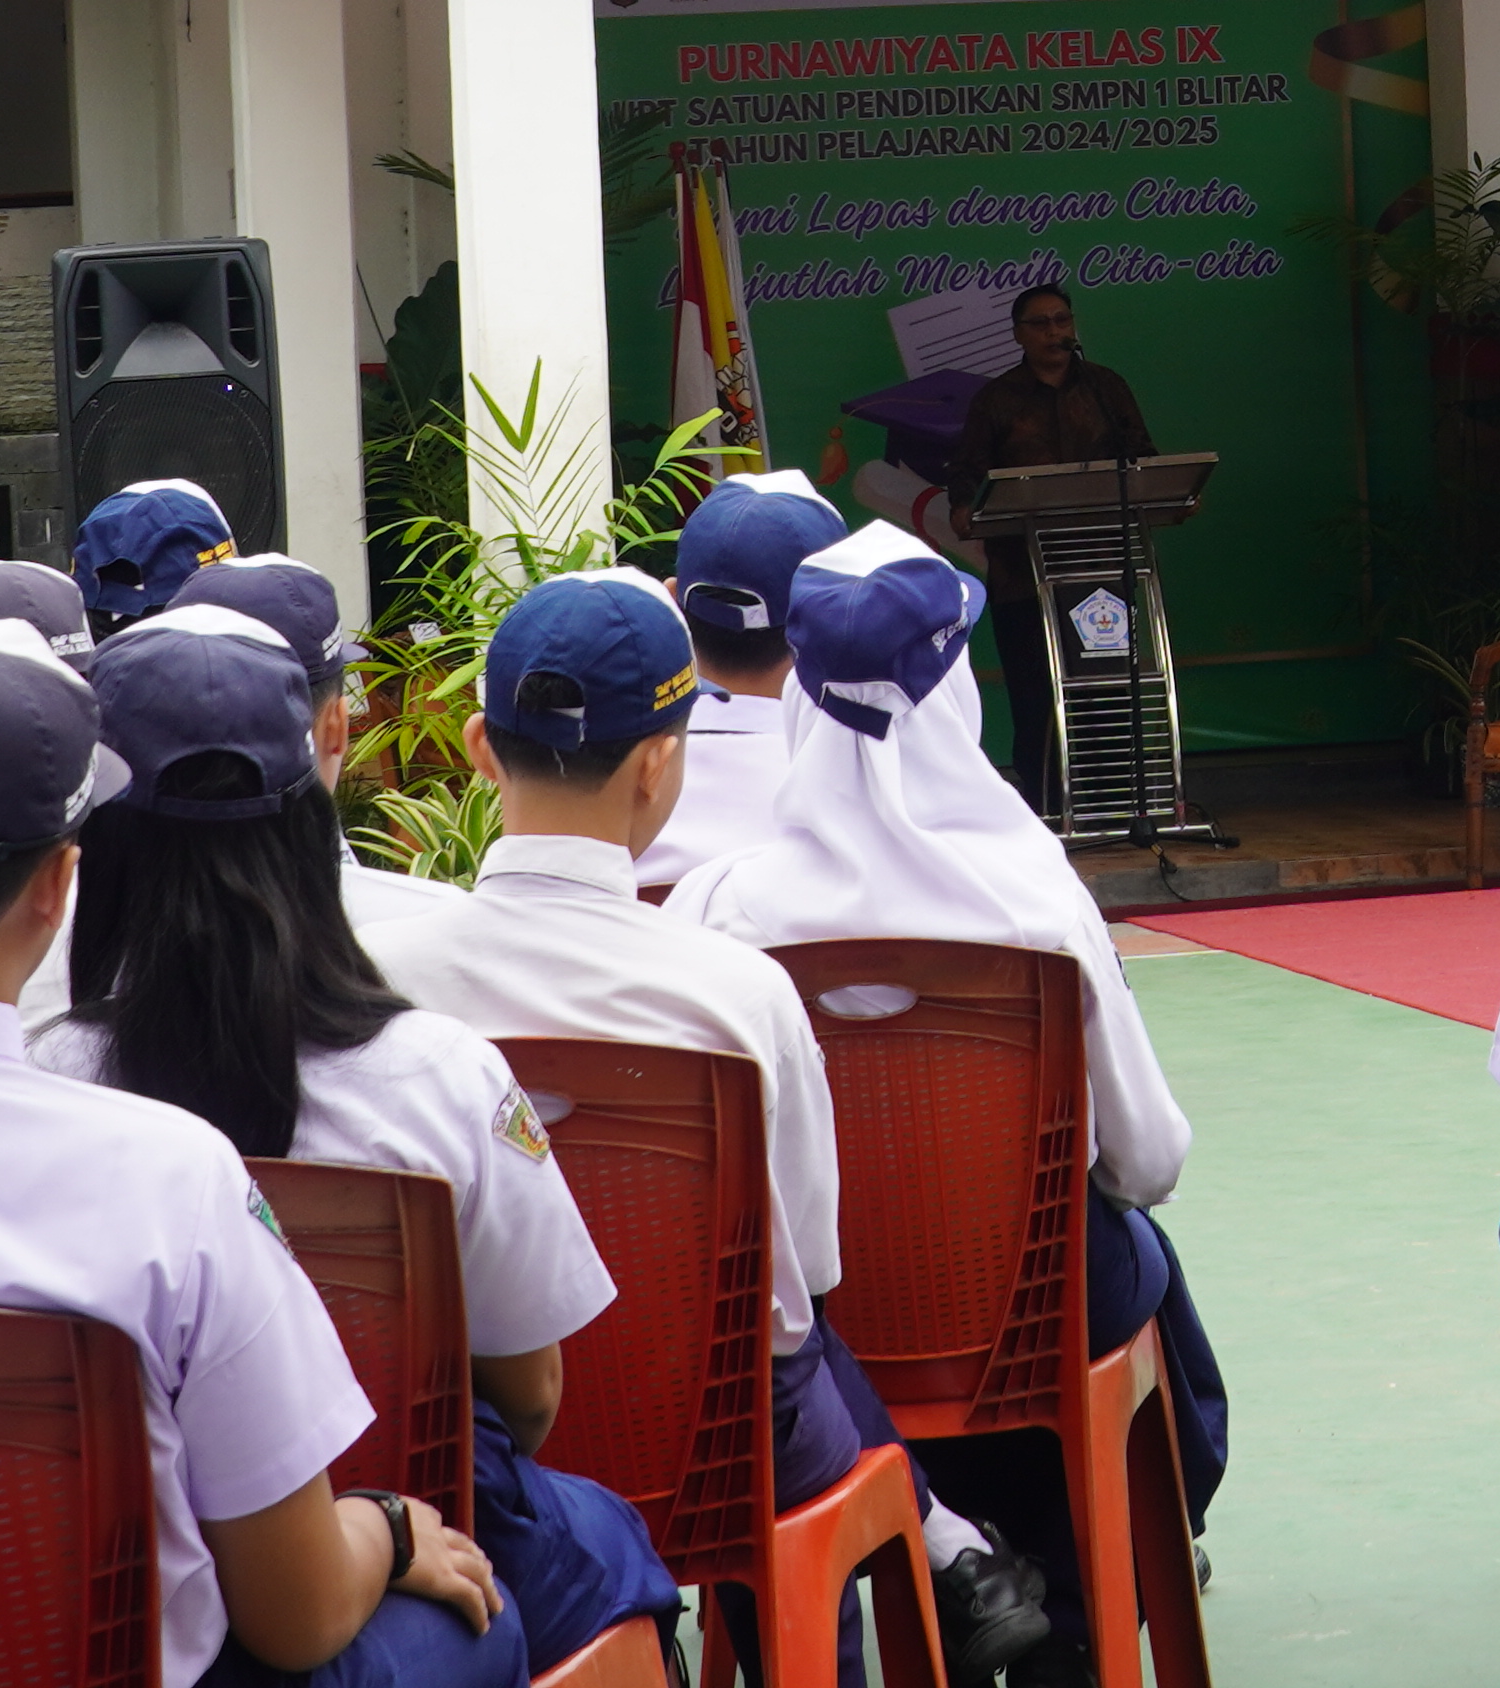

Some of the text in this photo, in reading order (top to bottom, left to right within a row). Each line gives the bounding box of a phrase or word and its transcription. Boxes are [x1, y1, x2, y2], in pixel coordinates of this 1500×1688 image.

[678, 24, 1227, 84] PURNAWIYATA KELAS IX
[686, 91, 828, 127] SATUAN
[835, 82, 1042, 121] PENDIDIKAN
[1051, 79, 1147, 113] SMPN
[1154, 77, 1170, 109] 1
[1176, 73, 1293, 108] BLITAR
[817, 123, 1013, 162] PELAJARAN
[1019, 115, 1220, 154] 2024/2025
[805, 191, 942, 242] Lepas
[946, 185, 1119, 236] dengan
[1124, 176, 1258, 222] Cinta,
[895, 248, 1072, 296] Meraih
[1077, 238, 1284, 290] Cita-cita
